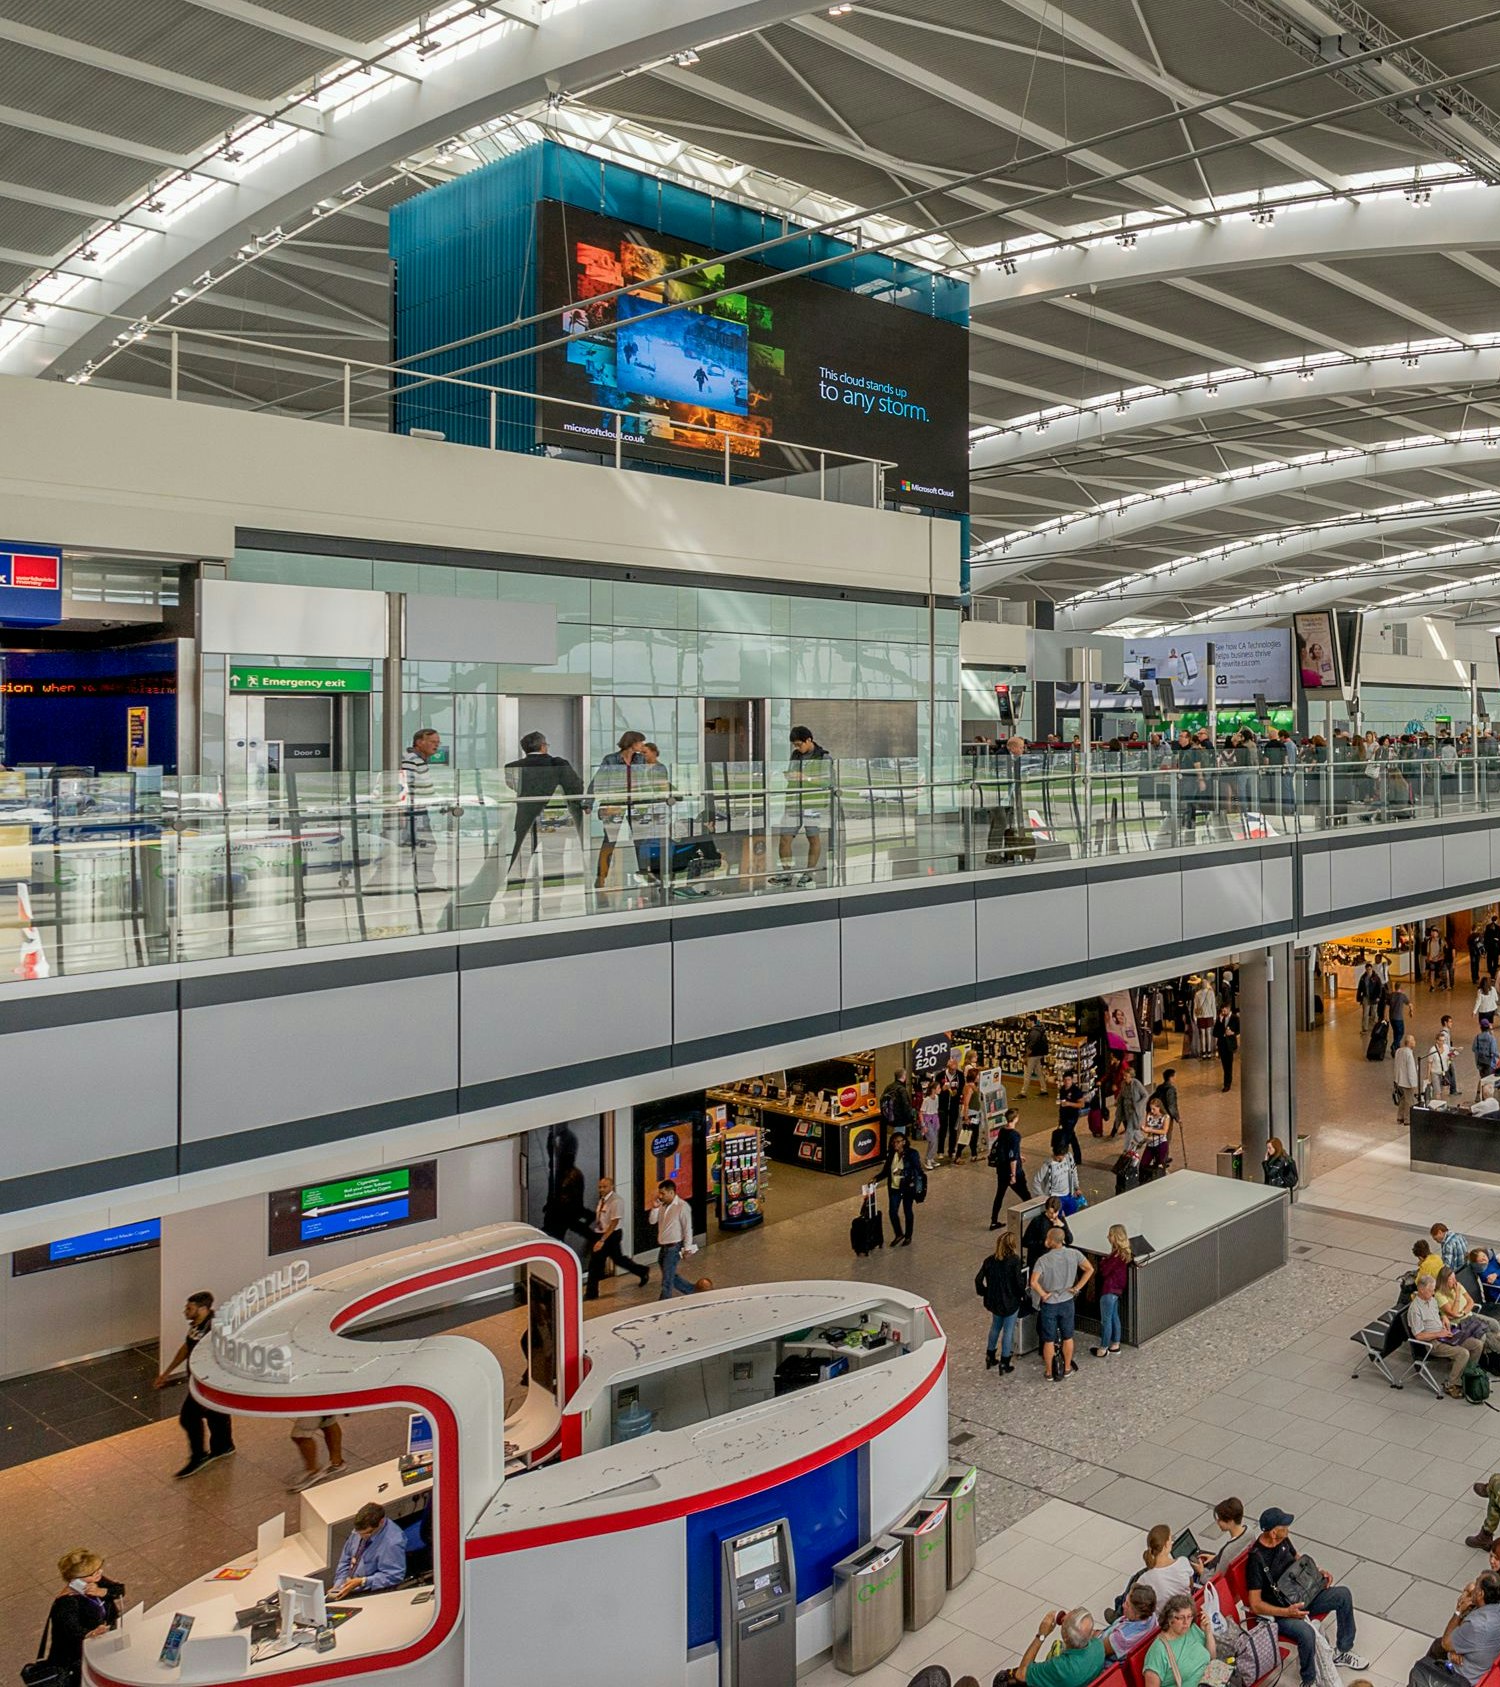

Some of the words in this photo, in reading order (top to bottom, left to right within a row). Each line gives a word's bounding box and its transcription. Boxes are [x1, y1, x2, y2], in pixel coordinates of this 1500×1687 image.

[819, 366, 838, 381] This
[839, 373, 865, 388] cloud
[866, 380, 894, 395] stands
[895, 388, 908, 400] up
[819, 380, 839, 401] to
[843, 389, 876, 414] any
[878, 397, 930, 422] storm.
[911, 483, 938, 495] Microsoft
[938, 488, 955, 498] Cloud
[1238, 642, 1247, 650] CA
[1247, 640, 1282, 649] Technologies
[1230, 651, 1254, 659] business
[42, 683, 76, 693] when
[262, 678, 323, 689] Emergency
[325, 678, 346, 688] exit
[915, 1048, 923, 1060] 2
[924, 1042, 948, 1057] FOR
[915, 1056, 937, 1071] £20
[654, 1134, 674, 1146] SAVE
[857, 1138, 873, 1147] Apple
